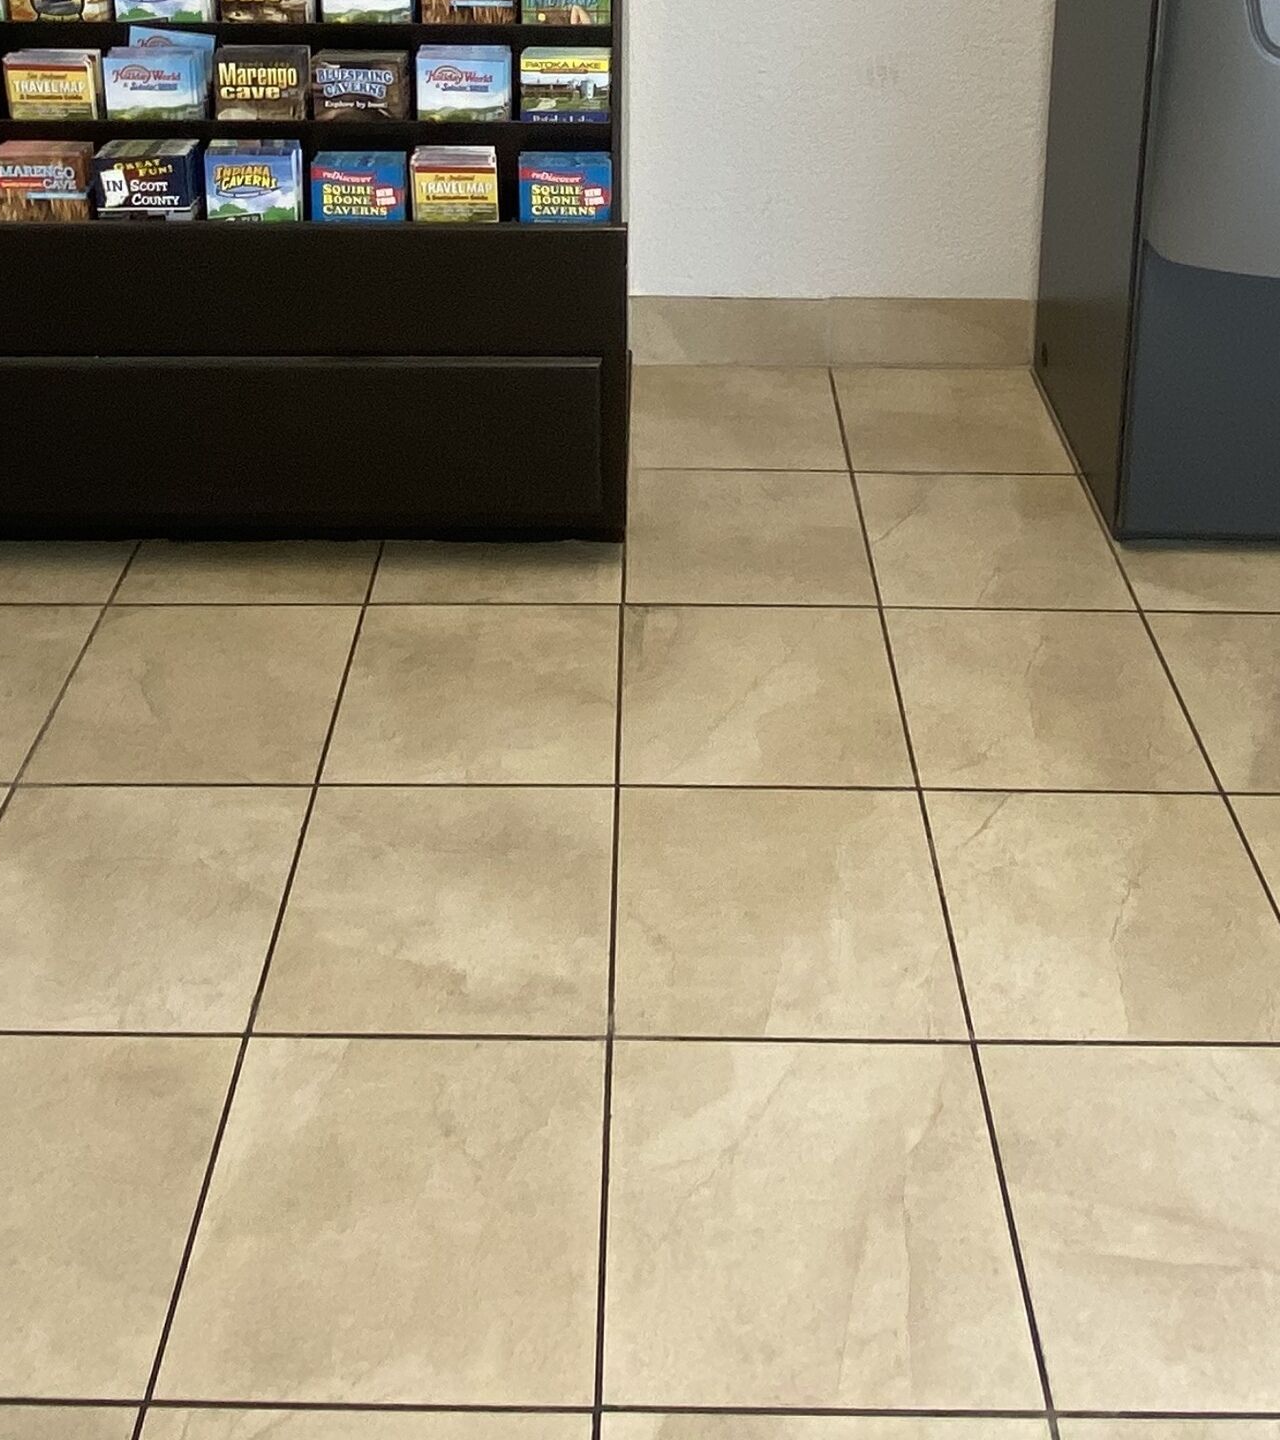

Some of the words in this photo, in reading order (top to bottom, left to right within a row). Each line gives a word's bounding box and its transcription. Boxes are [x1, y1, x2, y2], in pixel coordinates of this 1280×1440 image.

[112, 70, 152, 84] Holiday
[153, 71, 181, 81] World
[218, 63, 297, 88] Marengo
[316, 69, 394, 85] BLUESPRING
[426, 69, 463, 83] Holiday
[465, 72, 493, 83] World
[13, 82, 57, 93] TRAVEL
[57, 82, 86, 93] MAP
[220, 86, 282, 99] cave
[324, 82, 386, 99] CAVERNS
[113, 159, 160, 170] GREAT
[139, 165, 173, 177] FUN!
[215, 165, 271, 177] INDIANA
[42, 179, 76, 189] CAVE
[106, 180, 123, 192] IN
[130, 180, 168, 191] SCOTT
[220, 174, 277, 189] CAVERNS
[323, 184, 374, 196] SQUIRE
[421, 182, 465, 194] TRAVEL
[465, 182, 492, 194] MAP
[531, 185, 583, 195] SQUIRE
[131, 193, 180, 205] COUNTY
[323, 195, 370, 205] BOONE
[532, 196, 579, 205] BOONE
[323, 206, 388, 216] CAVERNS
[531, 206, 596, 215] CAVERNS
